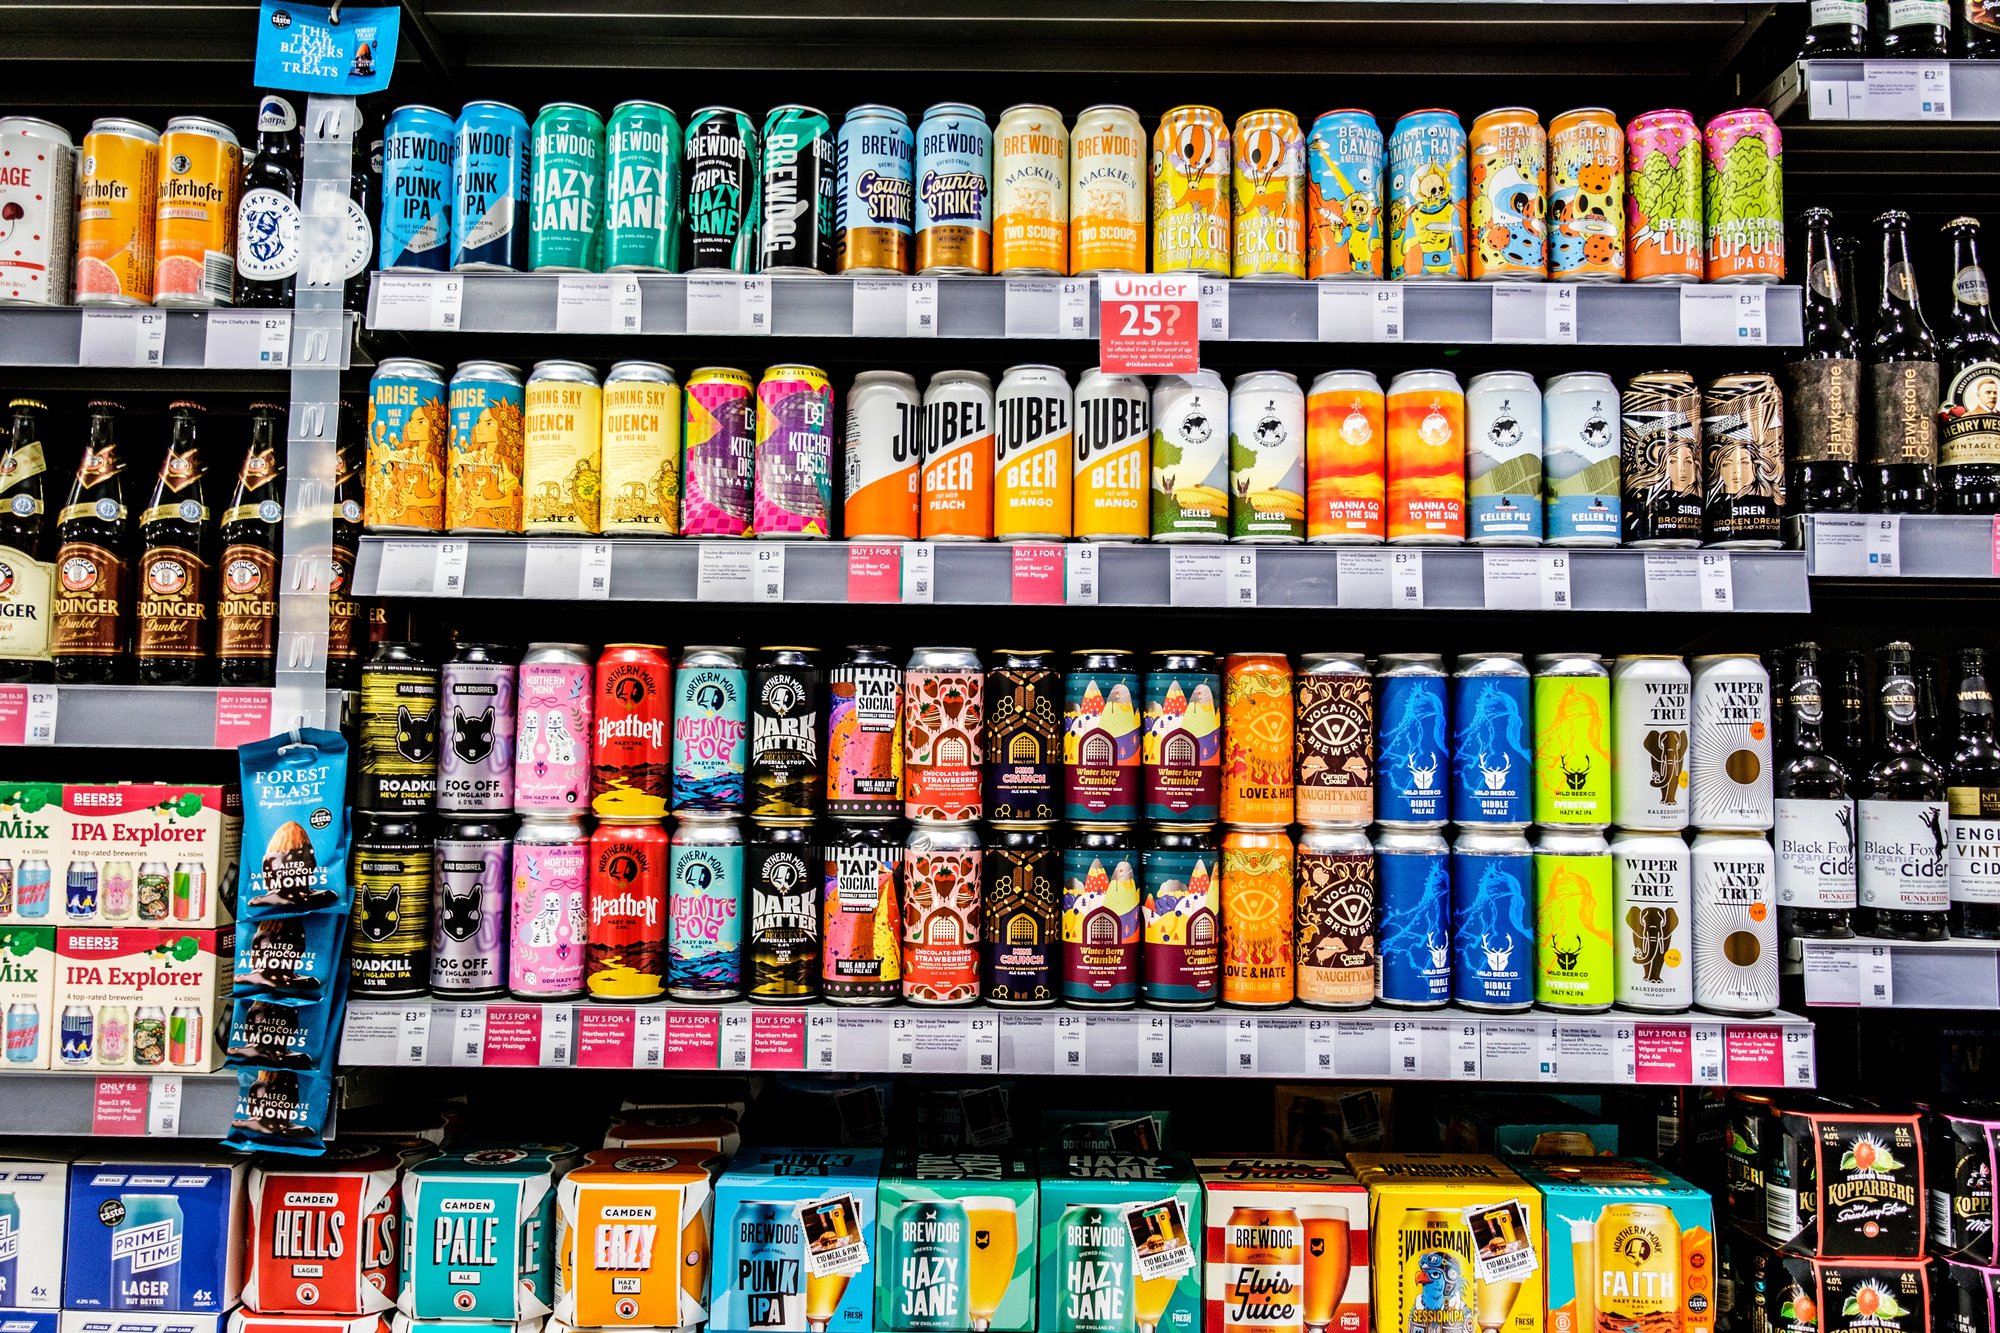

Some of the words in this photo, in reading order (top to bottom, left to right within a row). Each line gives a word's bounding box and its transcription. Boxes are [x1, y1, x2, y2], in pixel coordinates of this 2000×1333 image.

[301, 25, 329, 37] THE
[280, 42, 343, 59] BLAZERS
[292, 34, 335, 49] TRAIL
[282, 62, 338, 77] TREATS
[302, 54, 321, 66] OF
[535, 134, 595, 158] BREWDOG
[687, 136, 745, 160] BREWDOG
[924, 134, 983, 157] BREWDOG
[1003, 134, 1063, 159] BREWDOG
[533, 169, 594, 201] HAZY
[692, 170, 739, 192] TRIPLE
[921, 170, 986, 200] Counter
[1005, 166, 1064, 190] MACKIE'S
[396, 177, 441, 200] PUNK
[765, 134, 798, 250] BREWDOG
[404, 199, 430, 220] IPA
[690, 185, 739, 215] HAZY
[929, 192, 978, 220] STRIKE
[533, 200, 594, 233] JANE
[690, 210, 739, 236] JANE
[1003, 227, 1025, 240] TWO
[1028, 226, 1063, 241] SCOOPS
[447, 284, 458, 292] £3
[1115, 280, 1187, 296] Under
[1559, 289, 1570, 298] £4
[1120, 304, 1181, 336] 25?
[376, 385, 418, 405] ARISE
[1902, 368, 1916, 458] Hawkstone
[1079, 401, 1148, 461] JUBEL
[1917, 414, 1929, 458] Cider
[1944, 418, 1979, 438] HENRY
[789, 432, 831, 456] KITCHEN
[797, 452, 827, 474] DISCO
[926, 452, 972, 492] BEER
[1091, 450, 1141, 490] BEER
[930, 501, 965, 510] PEACH
[1094, 499, 1138, 508] MANGO
[1180, 508, 1211, 518] HELLES
[1329, 501, 1363, 511] WANNA
[1366, 502, 1379, 510] GO
[1732, 506, 1765, 515] SIREN
[1330, 510, 1341, 519] TO
[1343, 510, 1361, 520] THE
[1363, 510, 1379, 520] SUN
[1480, 512, 1512, 522] KELLER
[1515, 512, 1531, 522] PILS
[595, 545, 606, 554] £4
[917, 549, 927, 557] £3
[137, 602, 207, 620] ERDINGER
[145, 620, 188, 632] Dunkel
[526, 676, 565, 686] NORTHERN
[533, 685, 555, 694] MONK
[858, 680, 895, 696] TAP
[754, 712, 816, 738] DARK
[753, 736, 816, 759] MATTER
[255, 767, 329, 784] FOREST
[1003, 773, 1046, 784] CRUNCH
[1076, 769, 1098, 777] Winter
[1100, 769, 1120, 778] Berry
[1078, 776, 1116, 785] Crumble
[262, 783, 325, 798] FEAST
[445, 780, 471, 790] FOG
[475, 780, 499, 790] OFF
[1240, 788, 1269, 798] LOVE
[1271, 788, 1278, 798] &
[1280, 788, 1294, 798] HAT
[74, 793, 122, 806] BEER52
[1482, 800, 1509, 809] BIBBLE
[71, 823, 106, 841] IPA
[113, 824, 206, 846] Explorer
[1865, 841, 1906, 855] Black
[1911, 843, 1936, 856] Fox
[1901, 861, 1948, 876] cider
[252, 875, 328, 891] ALMONDS
[288, 1196, 334, 1204] CAMDEN
[1828, 1181, 1914, 1205] KOPPARBERG
[116, 1229, 166, 1251] PRIME
[274, 1211, 345, 1258] HELLS
[435, 1217, 498, 1265] PALE
[741, 1223, 798, 1244] BREWDOG
[139, 1245, 179, 1264] TIME
[596, 1225, 659, 1270] EAZY
[1405, 1230, 1471, 1263] WINGMAN
[902, 1258, 958, 1290] HAZY
[1236, 1267, 1293, 1294] Elvis
[1603, 1270, 1674, 1297] FAITH
[122, 1281, 169, 1296] LAGER
[1233, 1294, 1295, 1322] Juice
